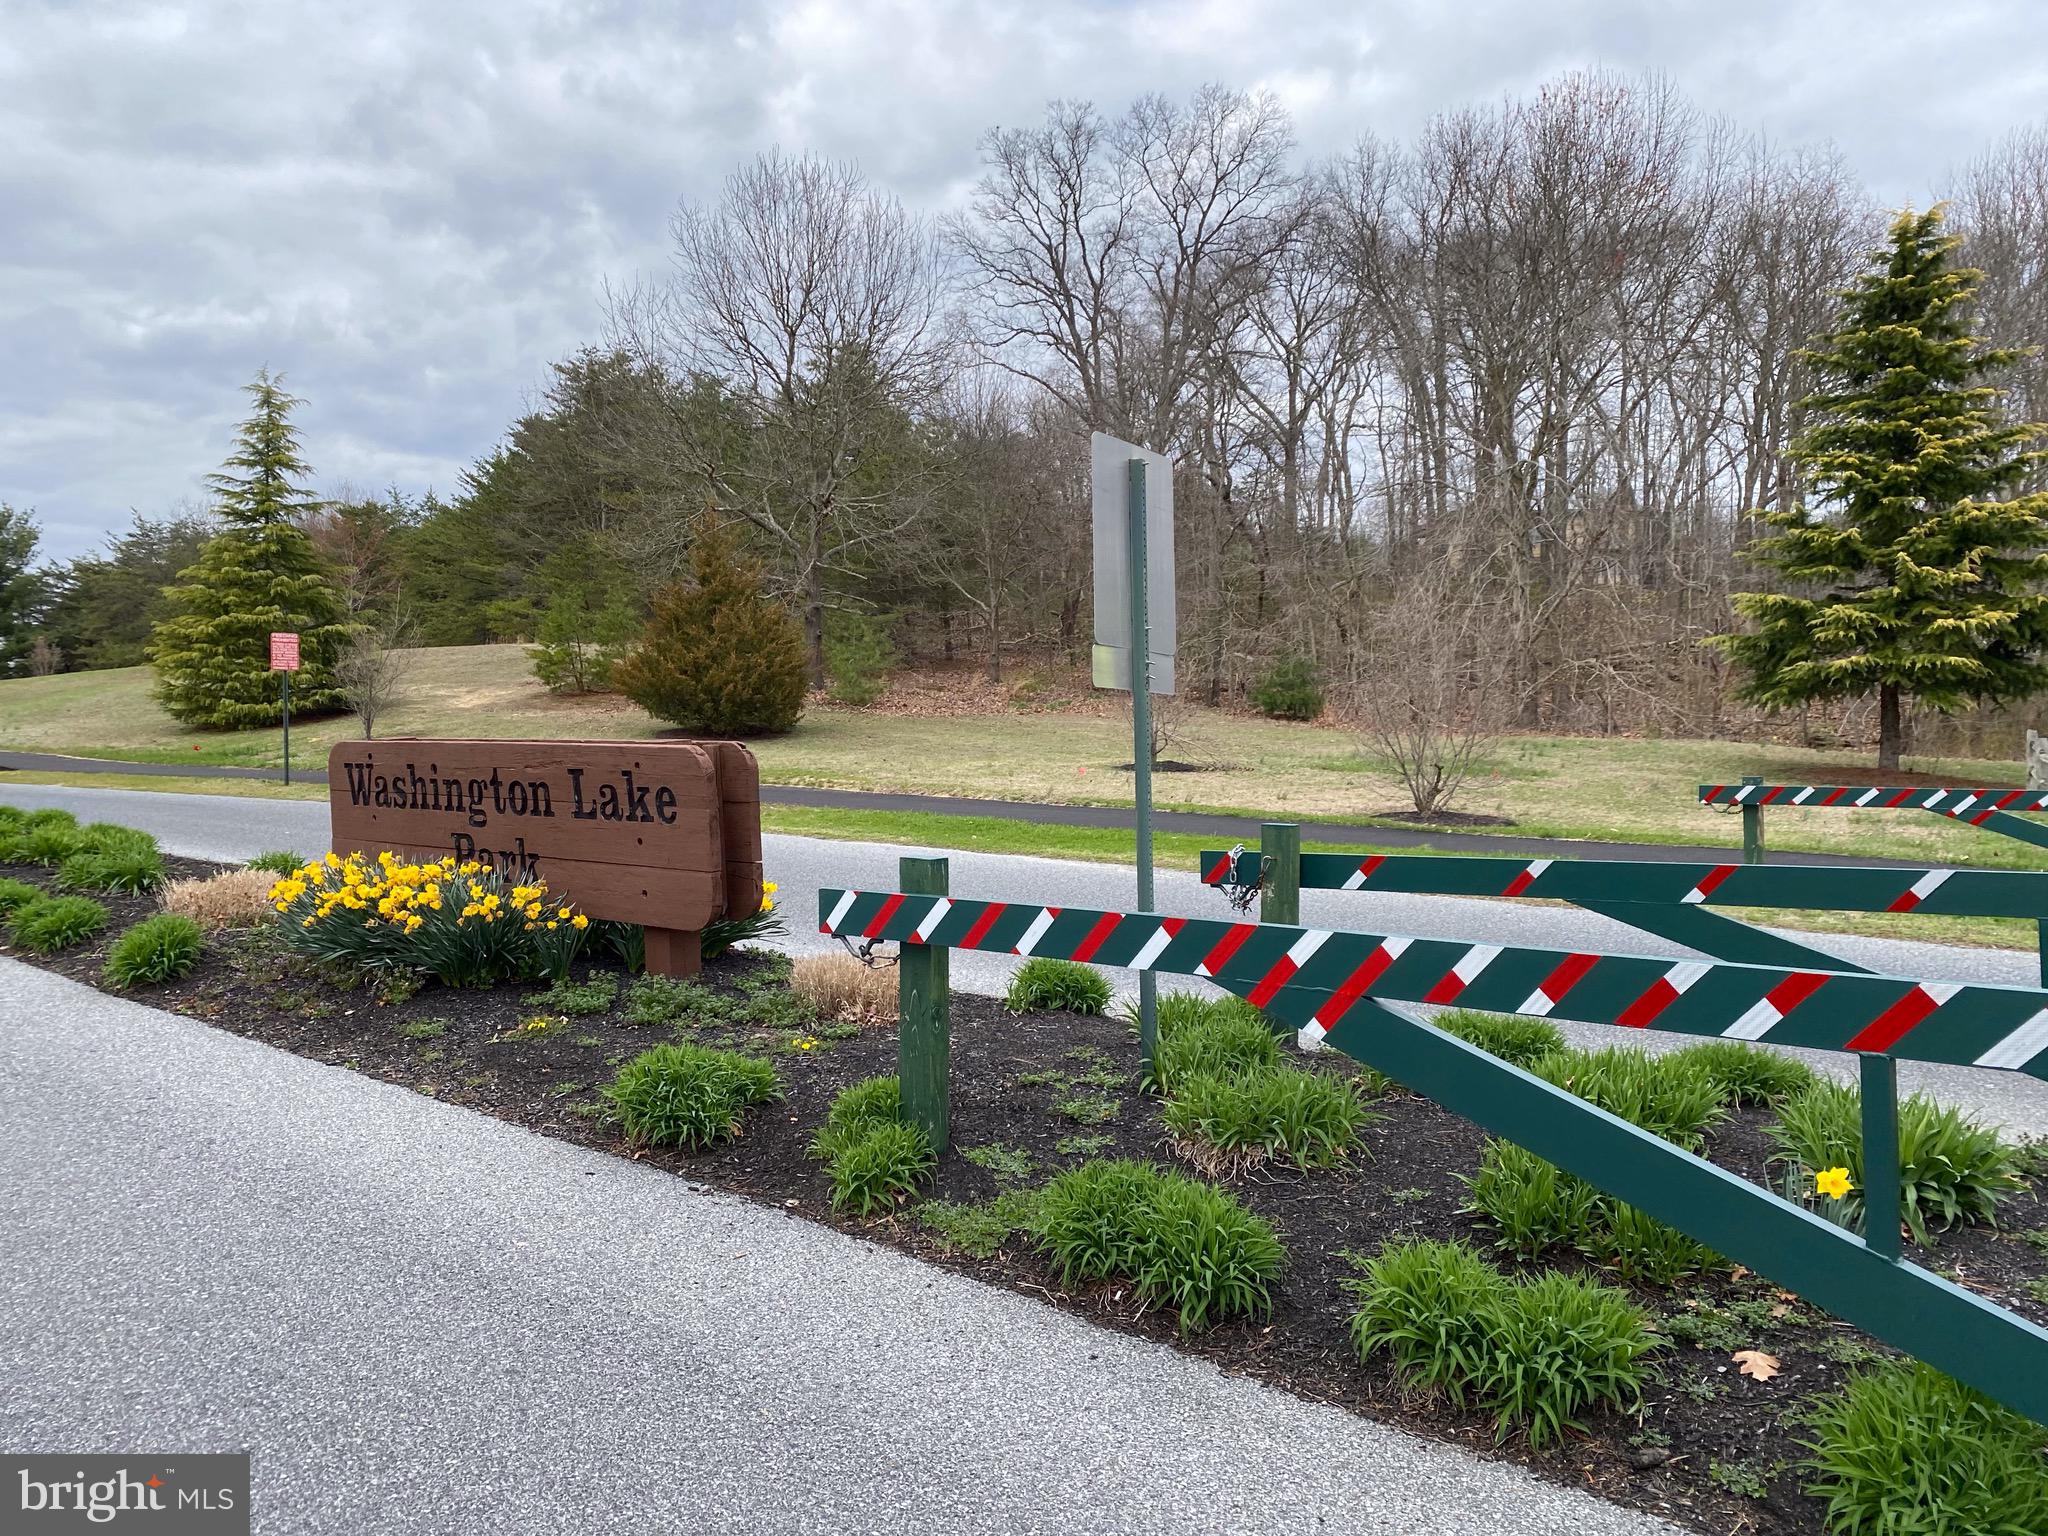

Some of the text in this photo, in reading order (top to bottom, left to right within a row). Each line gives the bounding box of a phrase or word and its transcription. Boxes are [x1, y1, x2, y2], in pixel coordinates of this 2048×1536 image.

[344, 762, 679, 828] Washington Lake
[450, 832, 540, 885] Park
